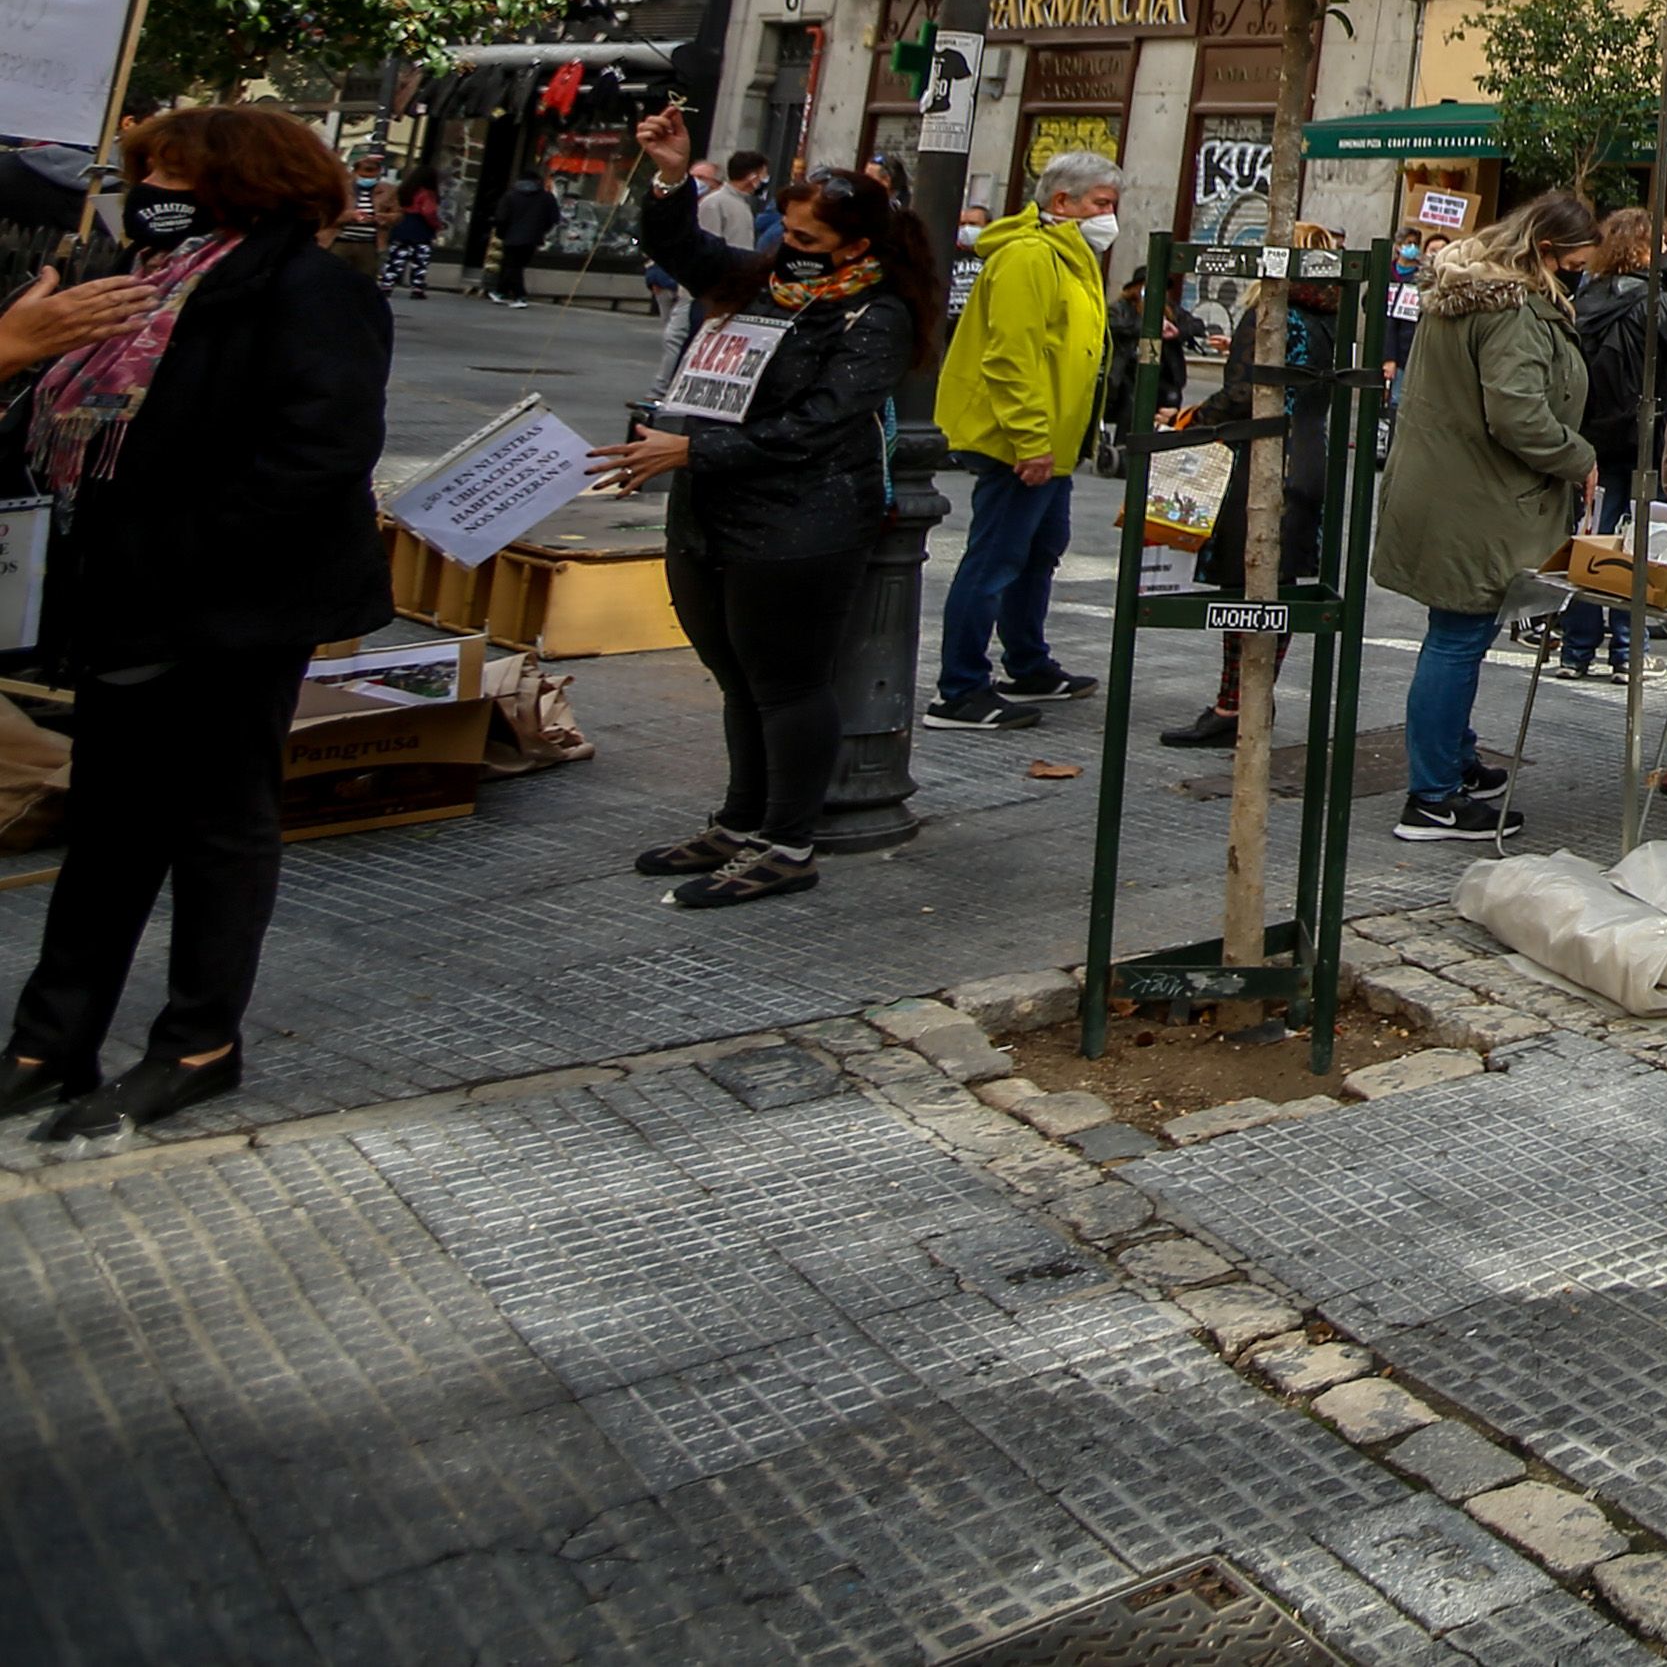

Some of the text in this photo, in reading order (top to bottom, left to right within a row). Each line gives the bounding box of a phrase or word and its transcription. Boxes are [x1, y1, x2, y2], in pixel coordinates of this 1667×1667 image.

[1387, 137, 1411, 148] CRAFT
[1413, 137, 1432, 148] BEER
[1437, 136, 1482, 148] HEALTHY
[454, 469, 477, 487] EN
[473, 424, 545, 473] NUESTRAS
[536, 449, 561, 467] NO
[448, 445, 541, 509] UBICACIONES
[463, 511, 496, 534] NOS
[290, 734, 421, 766] Pangrusa
